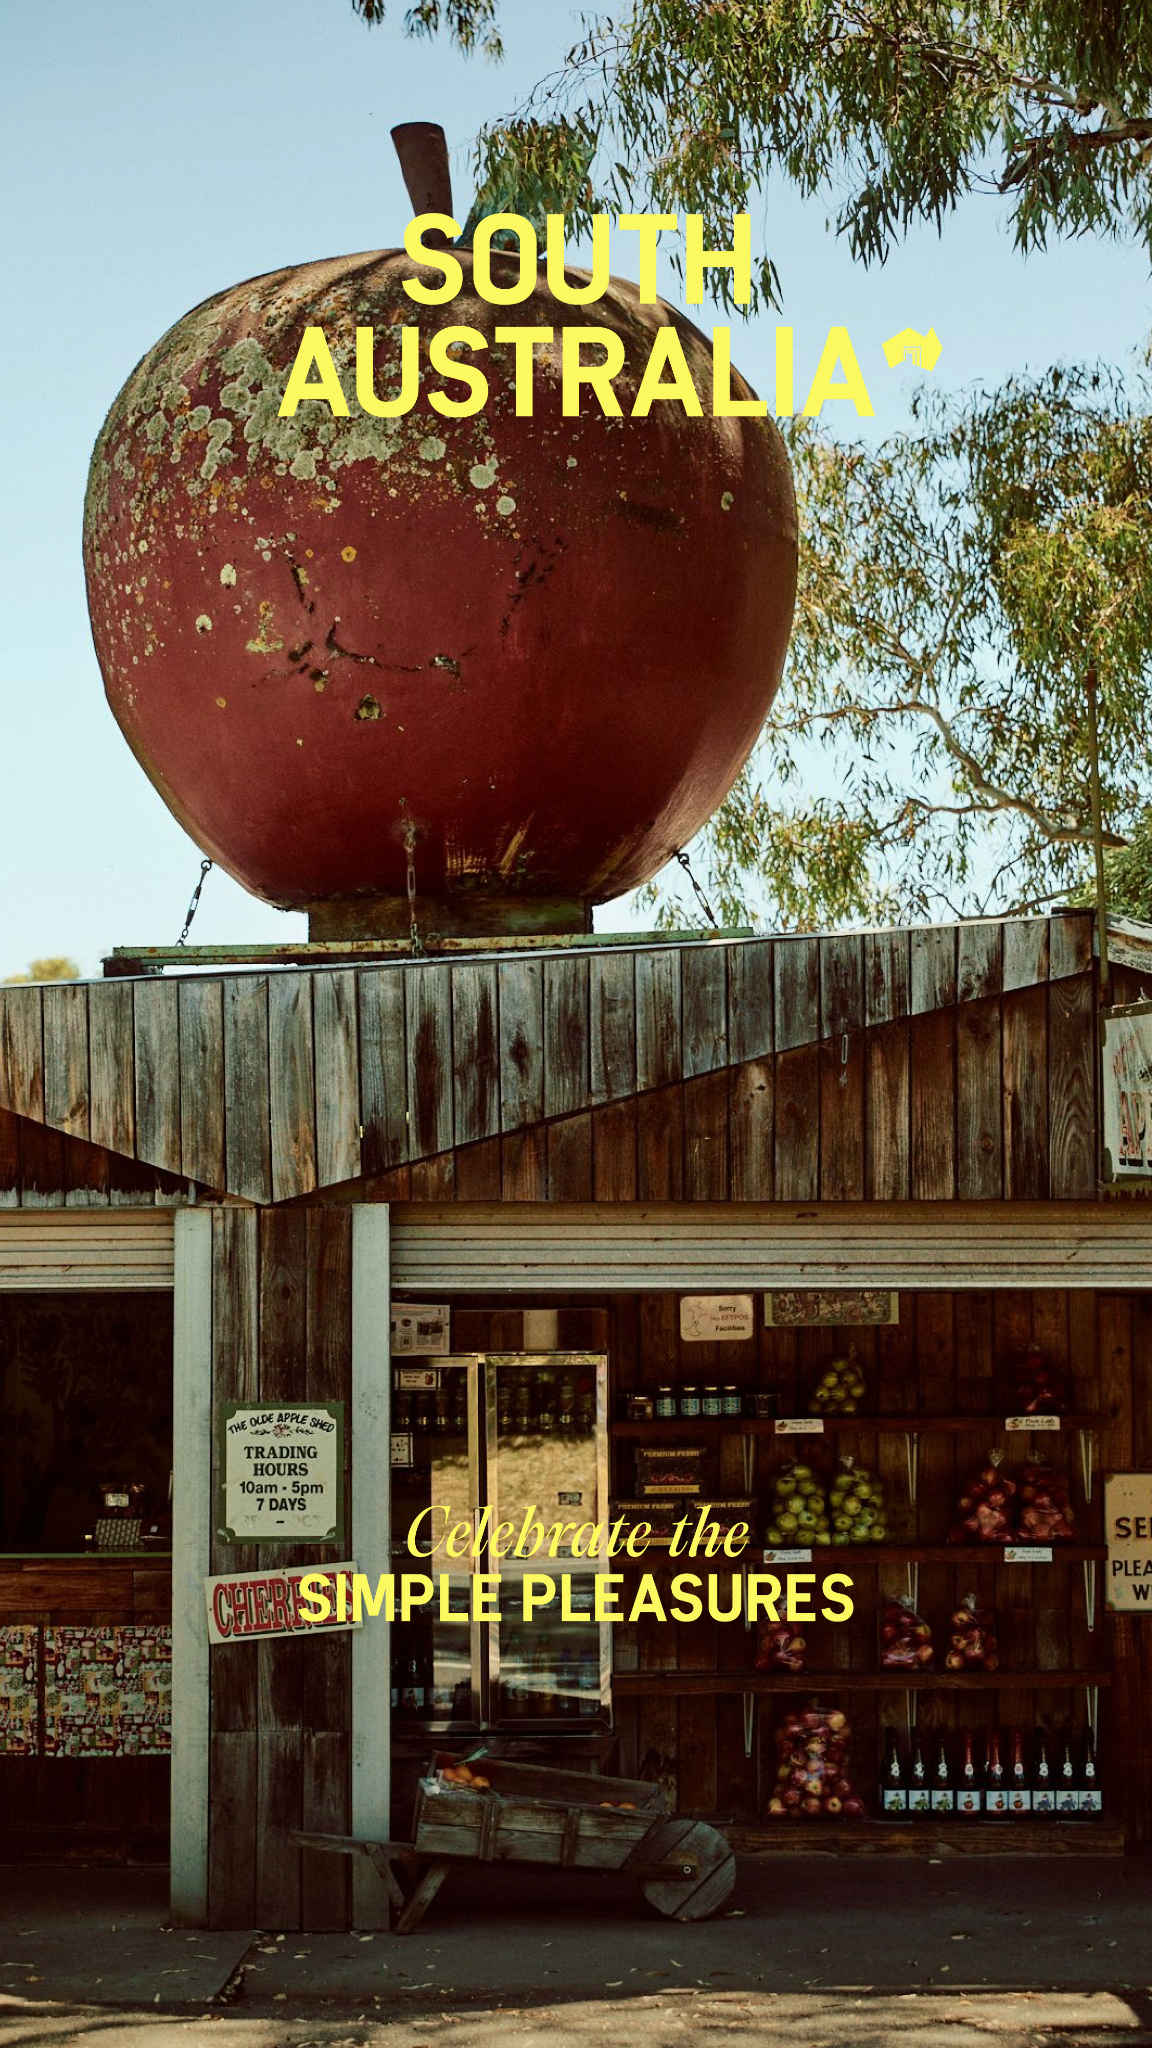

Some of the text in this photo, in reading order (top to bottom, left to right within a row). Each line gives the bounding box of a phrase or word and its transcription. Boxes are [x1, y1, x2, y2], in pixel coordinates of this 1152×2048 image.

[228, 1412, 335, 1434] THE OLDE APPLE SHED
[244, 1446, 318, 1459] TRADING
[253, 1463, 309, 1477] HOURS
[240, 1481, 278, 1494] 10am
[291, 1481, 323, 1496] 5pm
[256, 1498, 307, 1511] 7 DAYS
[1115, 1516, 1152, 1539] SE
